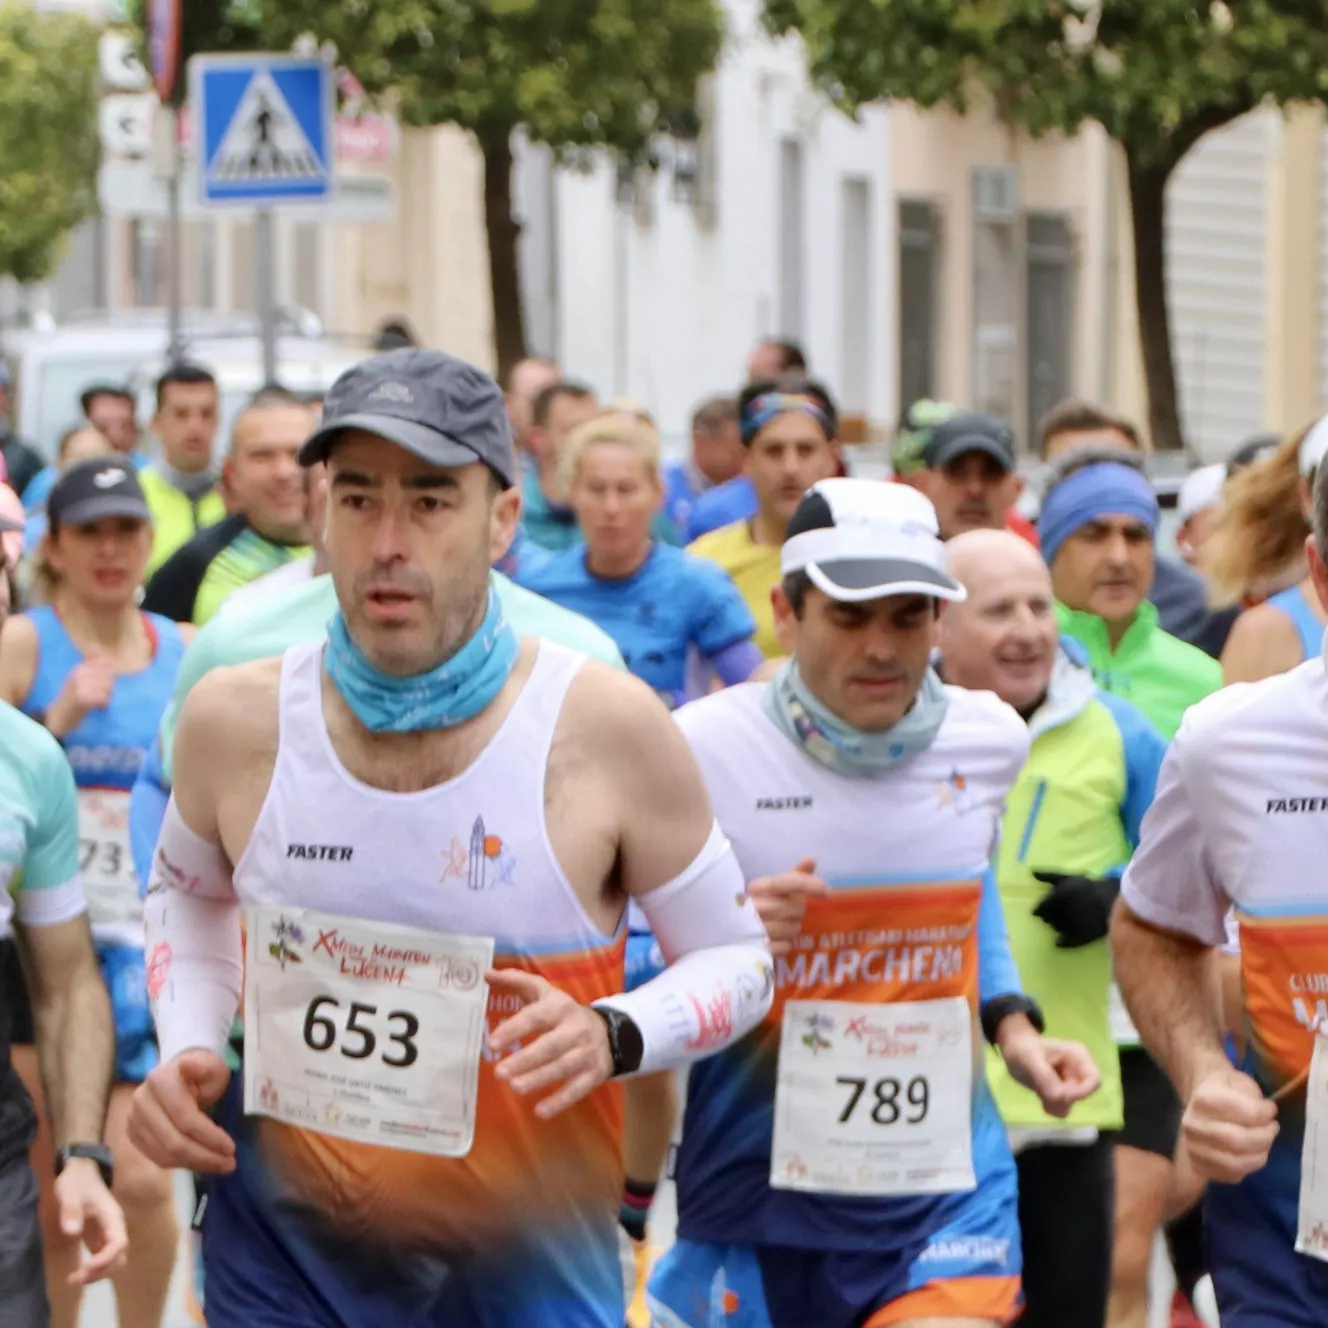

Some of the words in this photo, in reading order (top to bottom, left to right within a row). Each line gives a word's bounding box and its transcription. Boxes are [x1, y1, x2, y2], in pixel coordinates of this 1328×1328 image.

[756, 796, 813, 811] FASTER
[287, 844, 353, 861] FASTER
[339, 957, 407, 987] LUCENA
[303, 994, 420, 1068] 653
[836, 1075, 929, 1124] 789
